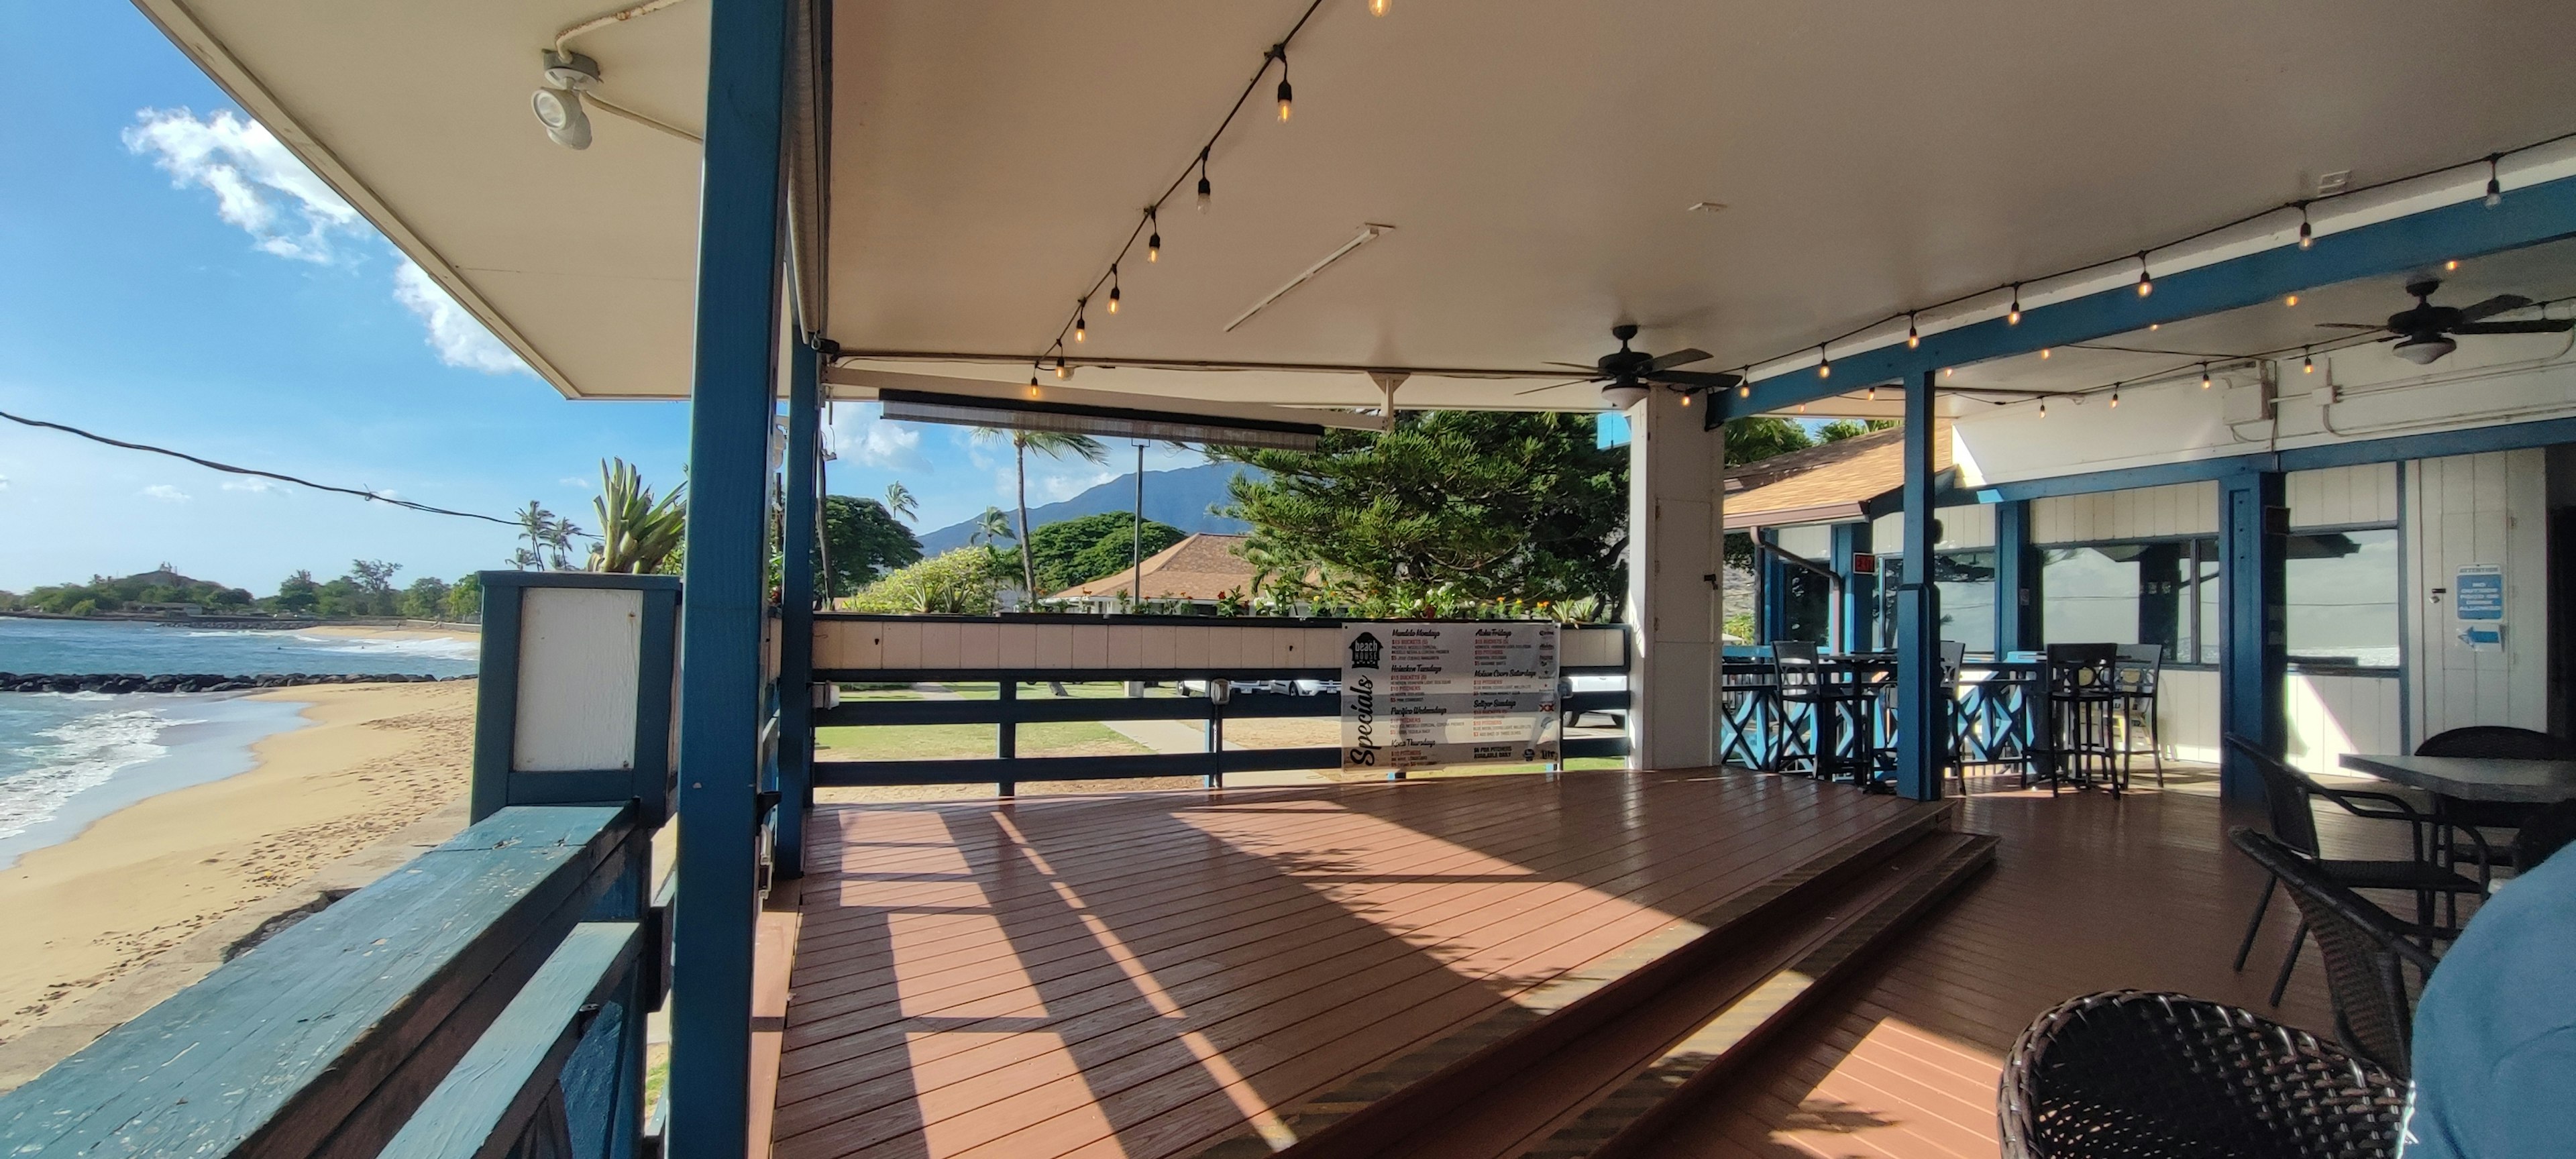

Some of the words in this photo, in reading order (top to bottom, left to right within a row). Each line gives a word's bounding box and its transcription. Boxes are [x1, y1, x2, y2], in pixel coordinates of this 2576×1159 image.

[1416, 629, 1440, 639] Mondays
[1475, 628, 1491, 637] Aloha
[1491, 628, 1512, 639] Fridays
[1355, 640, 1378, 651] beach
[1355, 652, 1377, 660] HOUSE
[1417, 665, 1442, 674] Tuesdays
[1474, 669, 1493, 677] Molson
[1493, 669, 1509, 677] Coors
[1509, 669, 1536, 678] Saturdays
[1473, 700, 1493, 709] Seltzer
[1493, 699, 1516, 709] Sundays
[1391, 707, 1413, 717] Pacifico
[1413, 706, 1447, 716] Wednesdays
[1350, 675, 1381, 766] Specials
[1406, 738, 1436, 748] Thursdays
